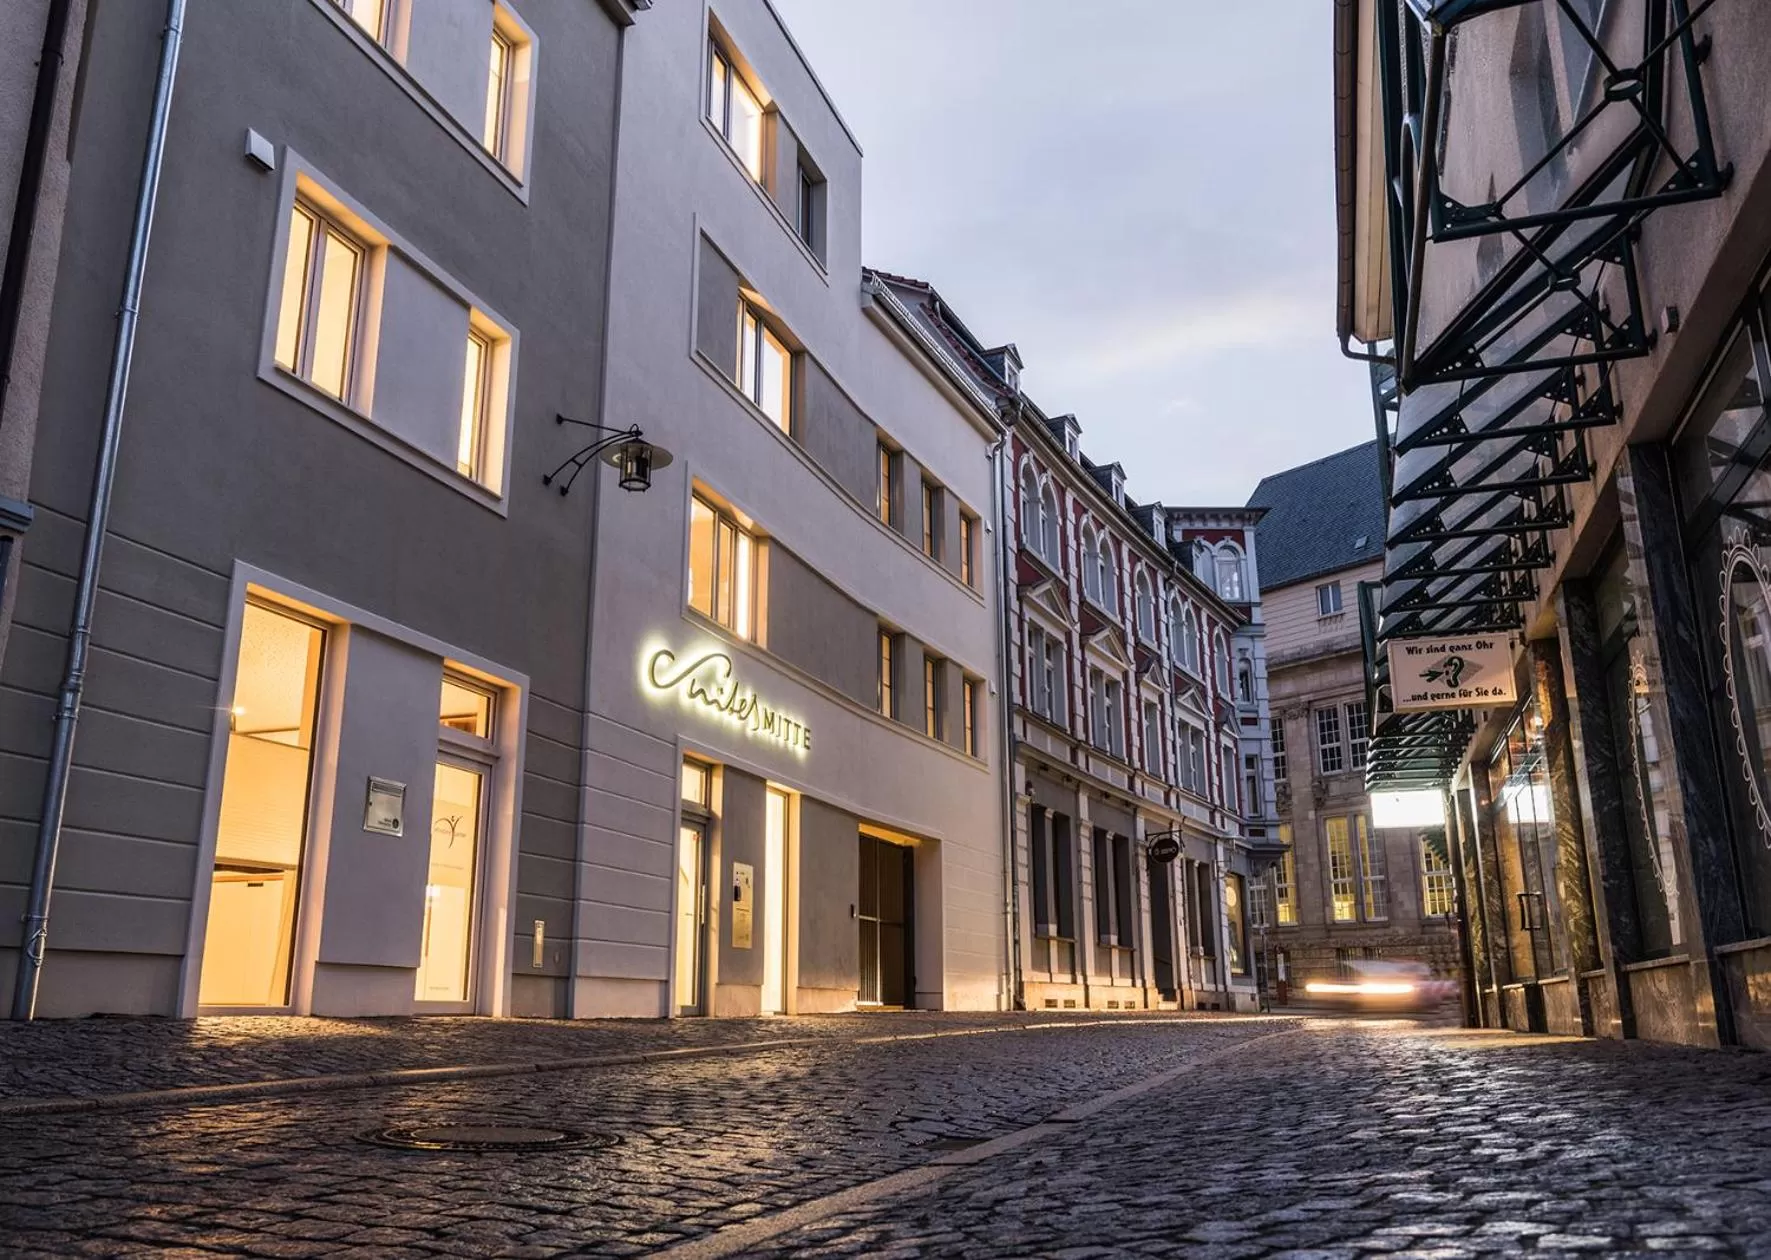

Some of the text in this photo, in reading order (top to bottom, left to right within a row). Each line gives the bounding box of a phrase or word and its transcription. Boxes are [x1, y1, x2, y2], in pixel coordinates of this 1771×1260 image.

[1405, 640, 1494, 655] Wir sind ganz Ohr
[1403, 686, 1507, 702] ...und gerne für Sie da.
[763, 708, 811, 750] MITTE
